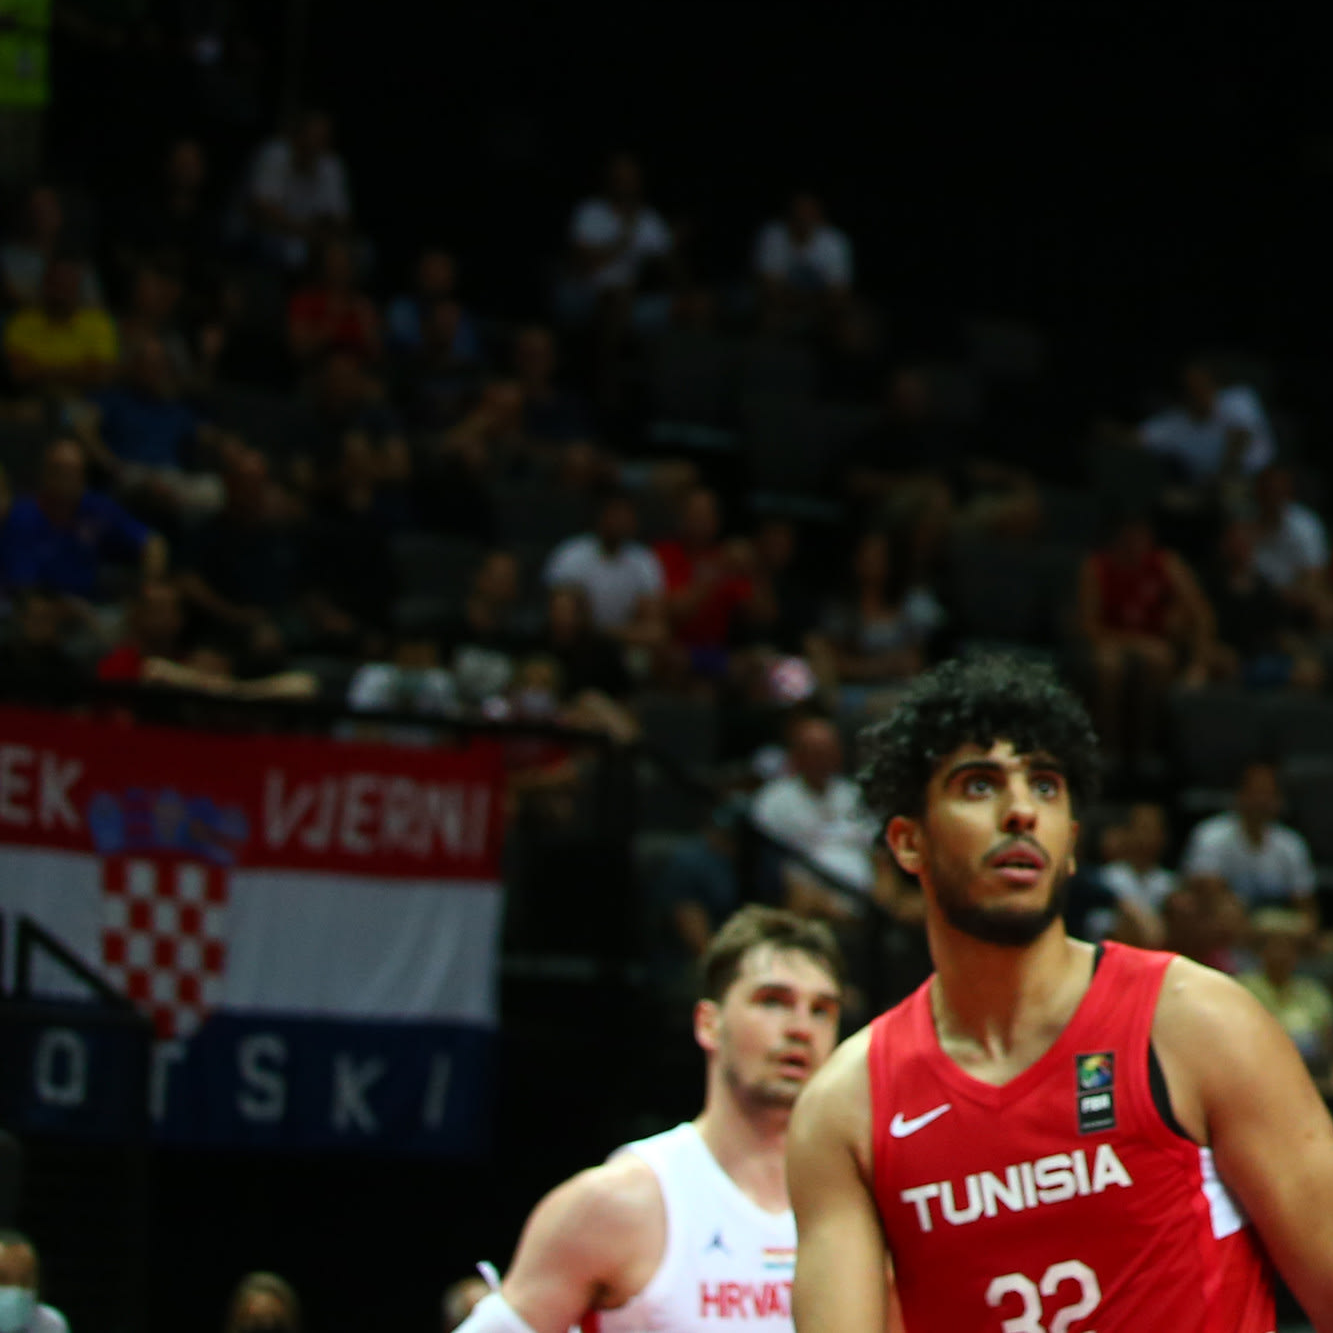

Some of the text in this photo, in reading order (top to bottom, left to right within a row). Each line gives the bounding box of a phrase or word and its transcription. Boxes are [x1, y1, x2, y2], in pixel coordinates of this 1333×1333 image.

[262, 768, 491, 860] VJERNI
[900, 1143, 1133, 1233] TUNISIA
[983, 1258, 1103, 1333] 32
